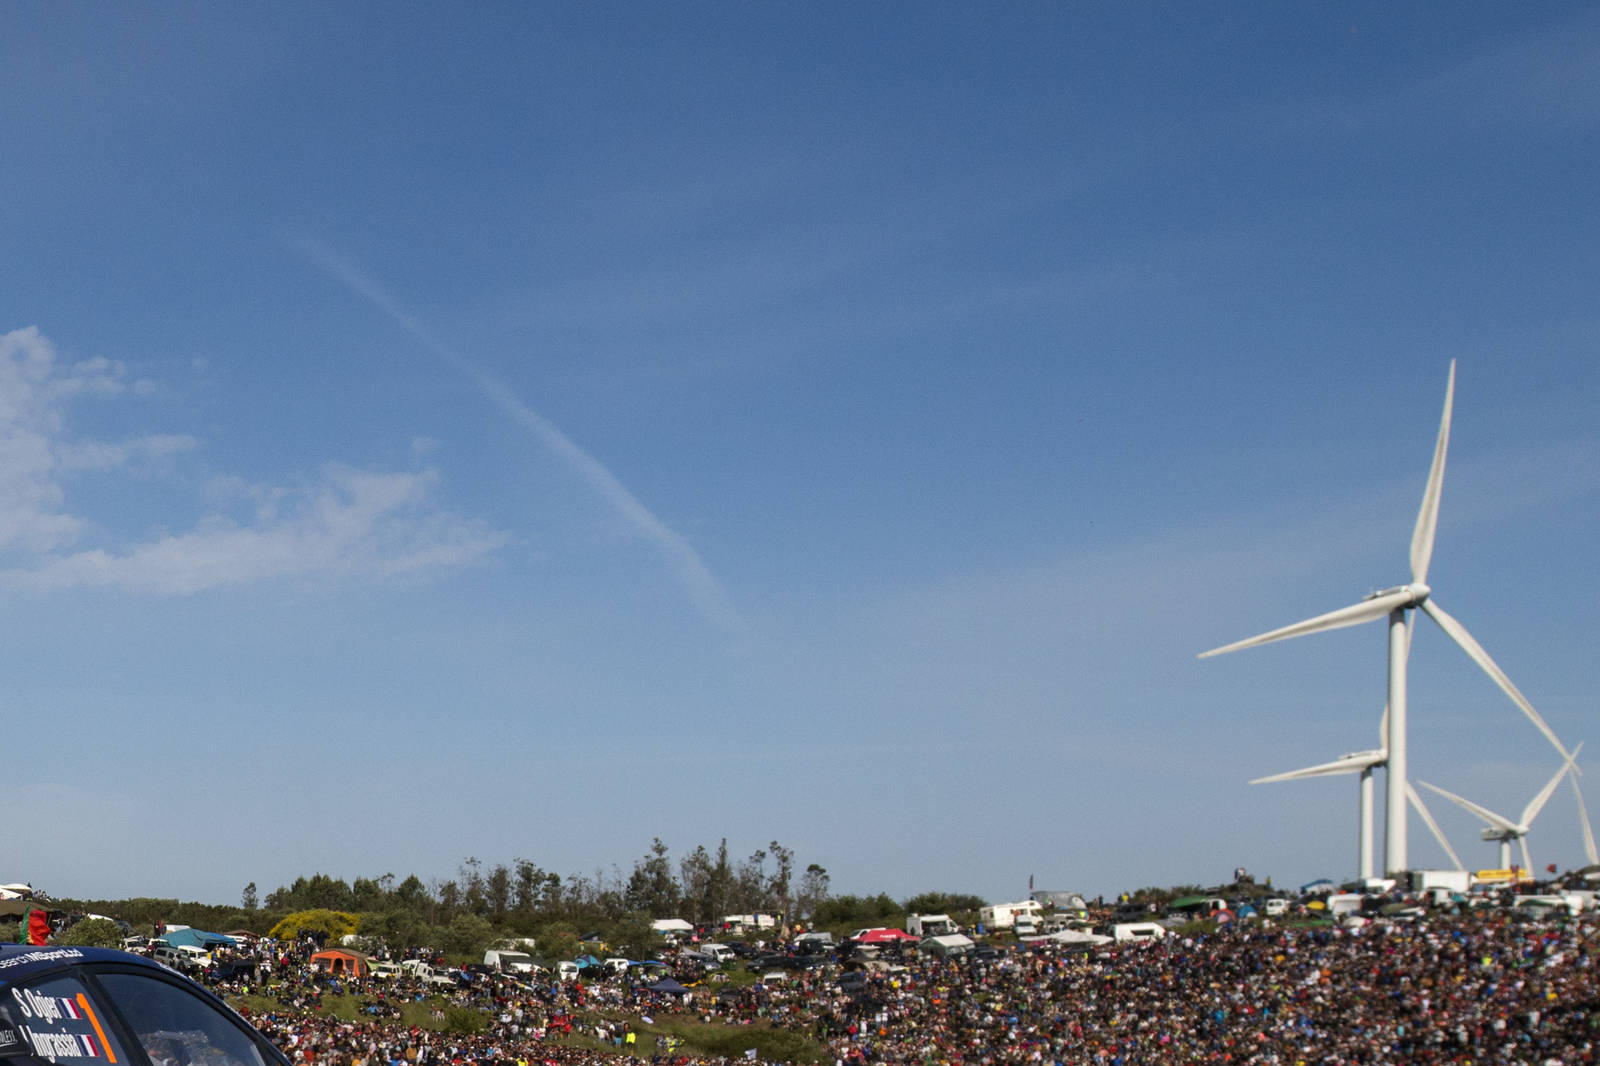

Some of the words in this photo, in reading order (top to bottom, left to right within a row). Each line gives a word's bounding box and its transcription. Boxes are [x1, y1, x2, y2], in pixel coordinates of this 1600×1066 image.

[11, 987, 32, 1018] S
[23, 988, 63, 1024] Ogier
[26, 1025, 83, 1064] Ingrassia
[76, 993, 118, 1064] 1
